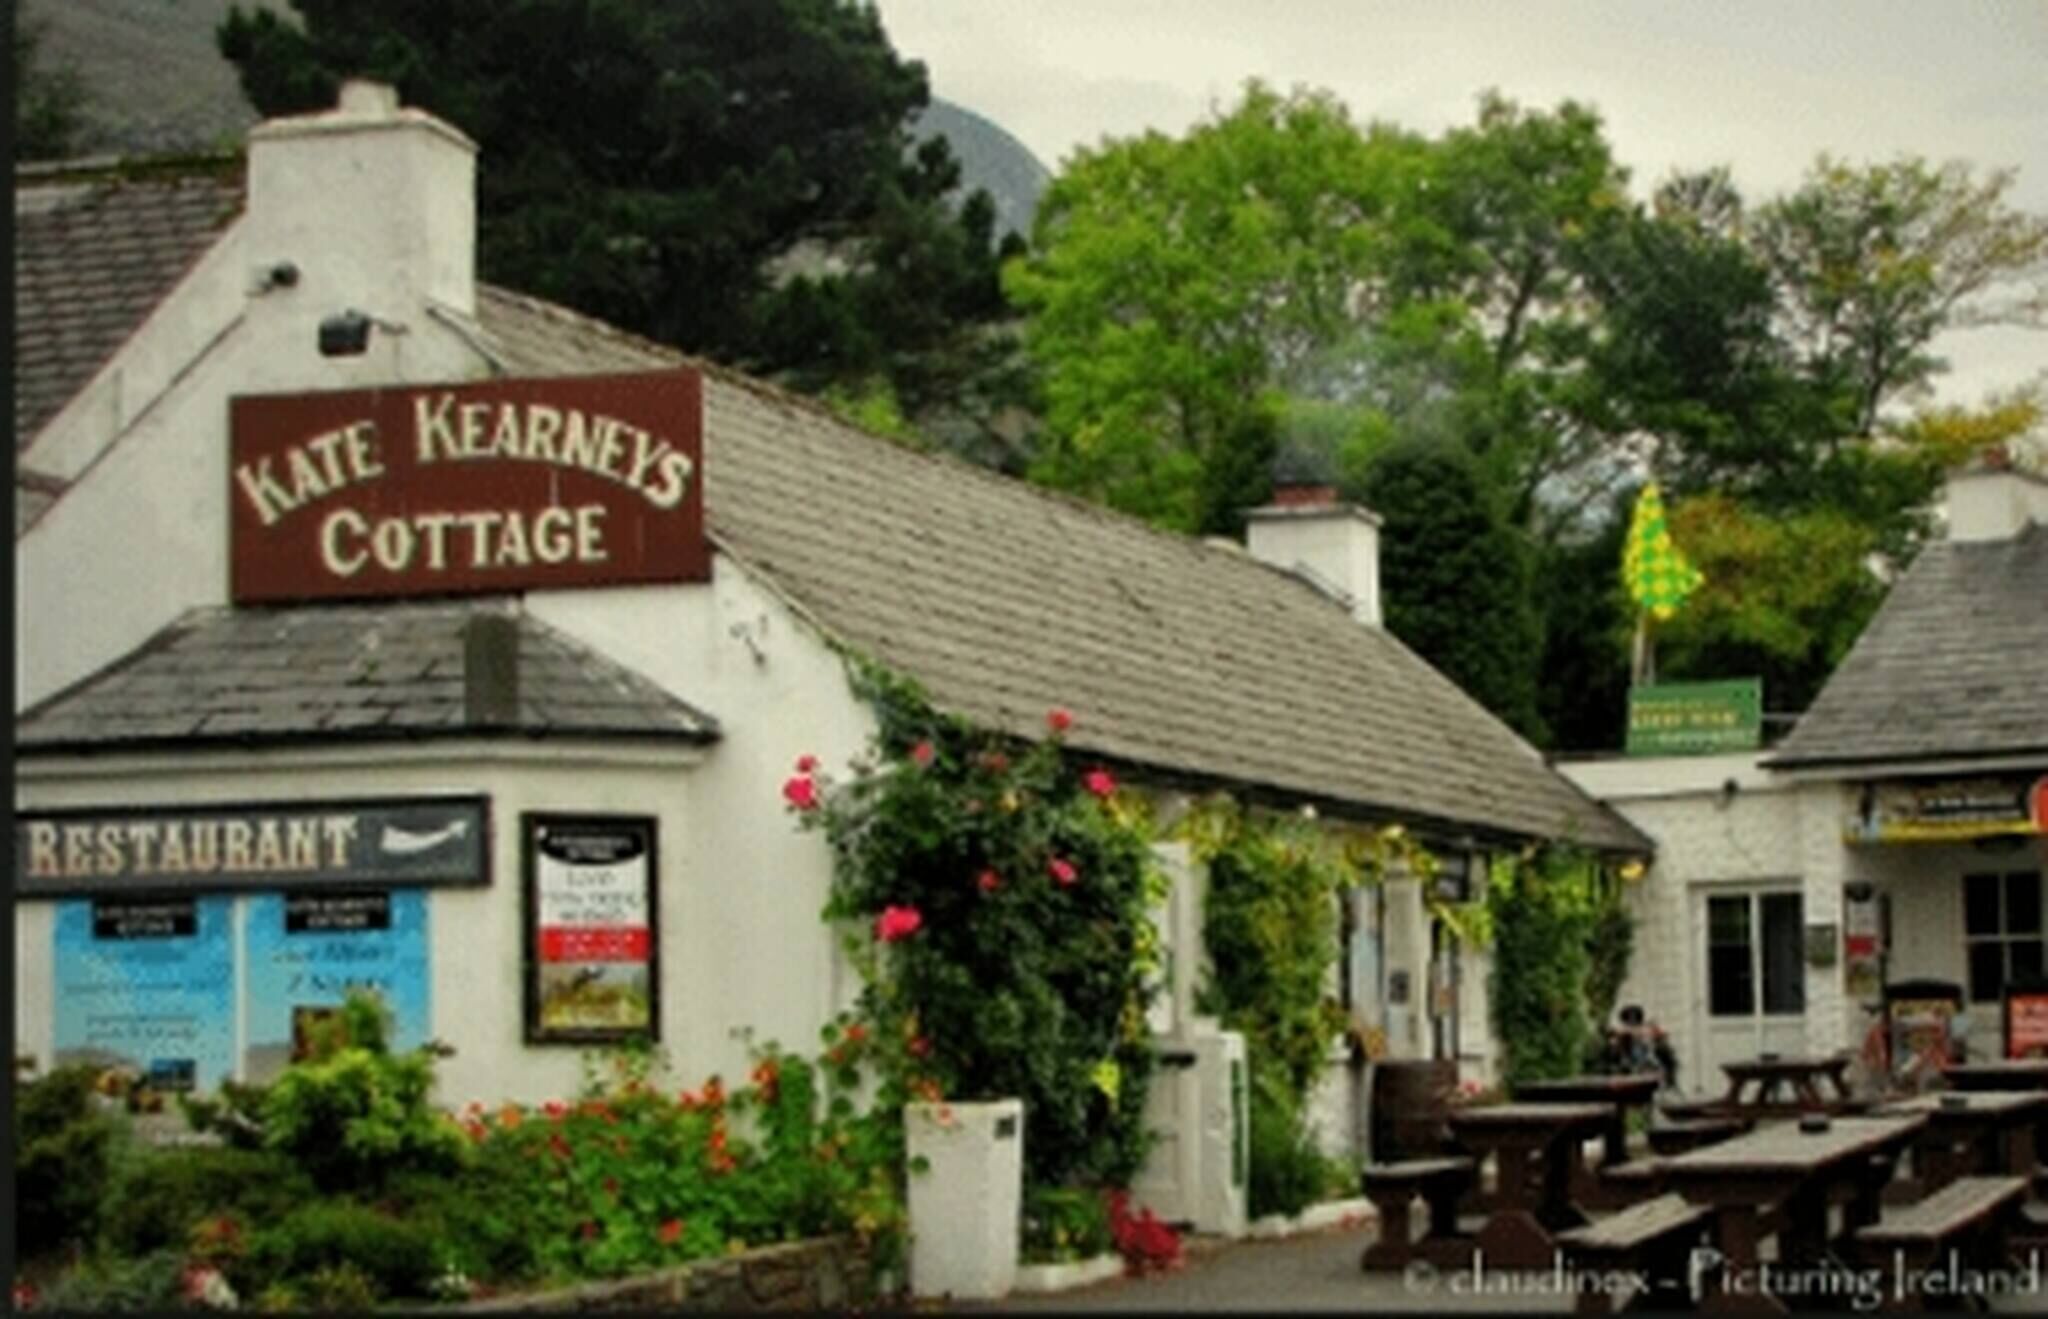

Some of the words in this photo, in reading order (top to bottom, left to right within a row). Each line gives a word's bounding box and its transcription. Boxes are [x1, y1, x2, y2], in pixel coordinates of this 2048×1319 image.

[236, 419, 385, 526] KATE
[320, 506, 608, 576] COTTAGE
[27, 815, 358, 878] RESTAURANT
